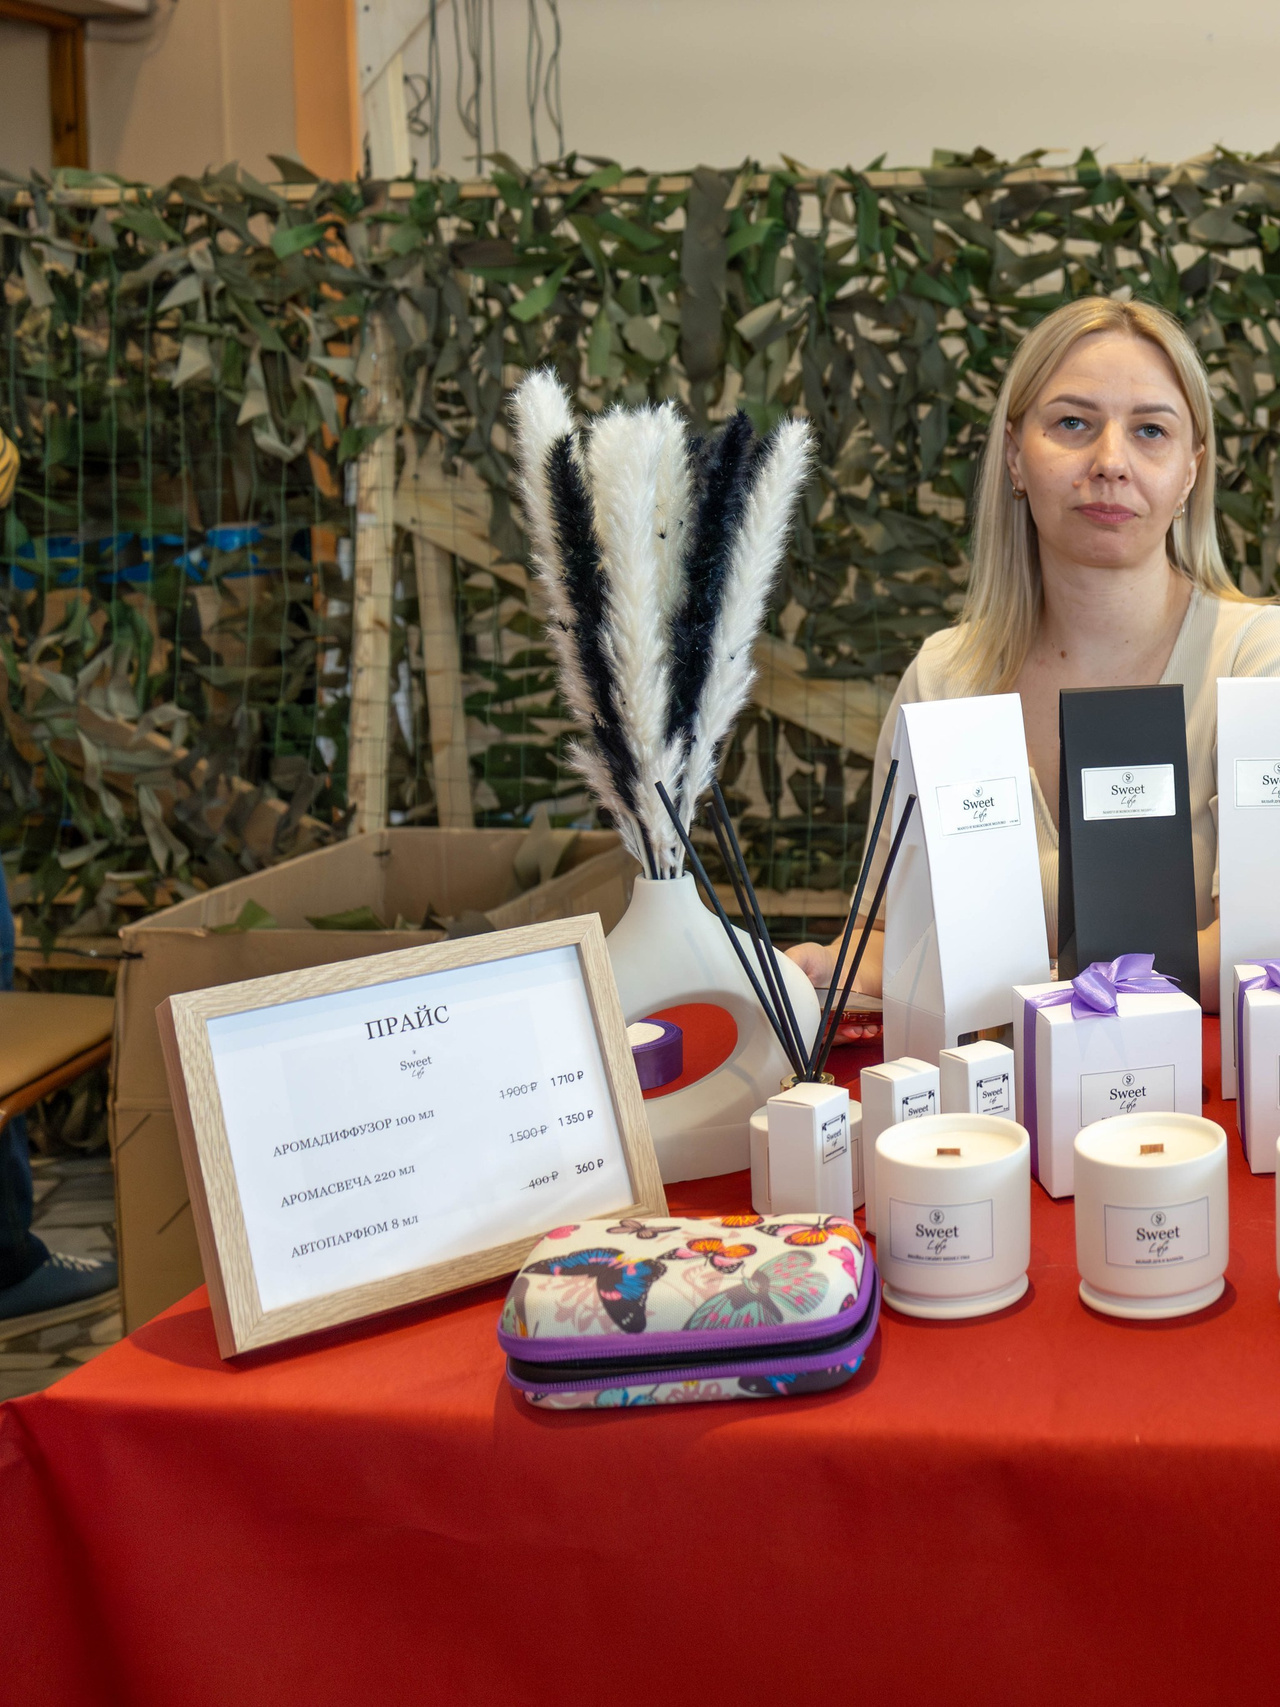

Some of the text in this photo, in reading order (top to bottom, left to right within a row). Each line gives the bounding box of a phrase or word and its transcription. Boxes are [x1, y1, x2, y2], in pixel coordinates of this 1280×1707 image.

[1111, 784, 1145, 796] Sweet
[963, 797, 995, 811] Sweet
[364, 1005, 450, 1040] ПРАЙС
[399, 1055, 433, 1071] Sweet
[1109, 1086, 1147, 1101] Sweet
[273, 1118, 392, 1157] АРОМАДИФФУЗОР
[395, 1114, 416, 1127] 100
[418, 1110, 435, 1121] мл
[281, 1175, 372, 1208] АРОМАСВЕЧА
[374, 1170, 396, 1183] 220
[399, 1165, 416, 1177] мл
[291, 1221, 388, 1259] АВТОПАРФЮМ
[391, 1218, 400, 1231] 8
[402, 1215, 419, 1227] мл
[575, 1161, 595, 1175] 360
[915, 1223, 959, 1238] Sweet
[1136, 1225, 1180, 1241] Sweet
